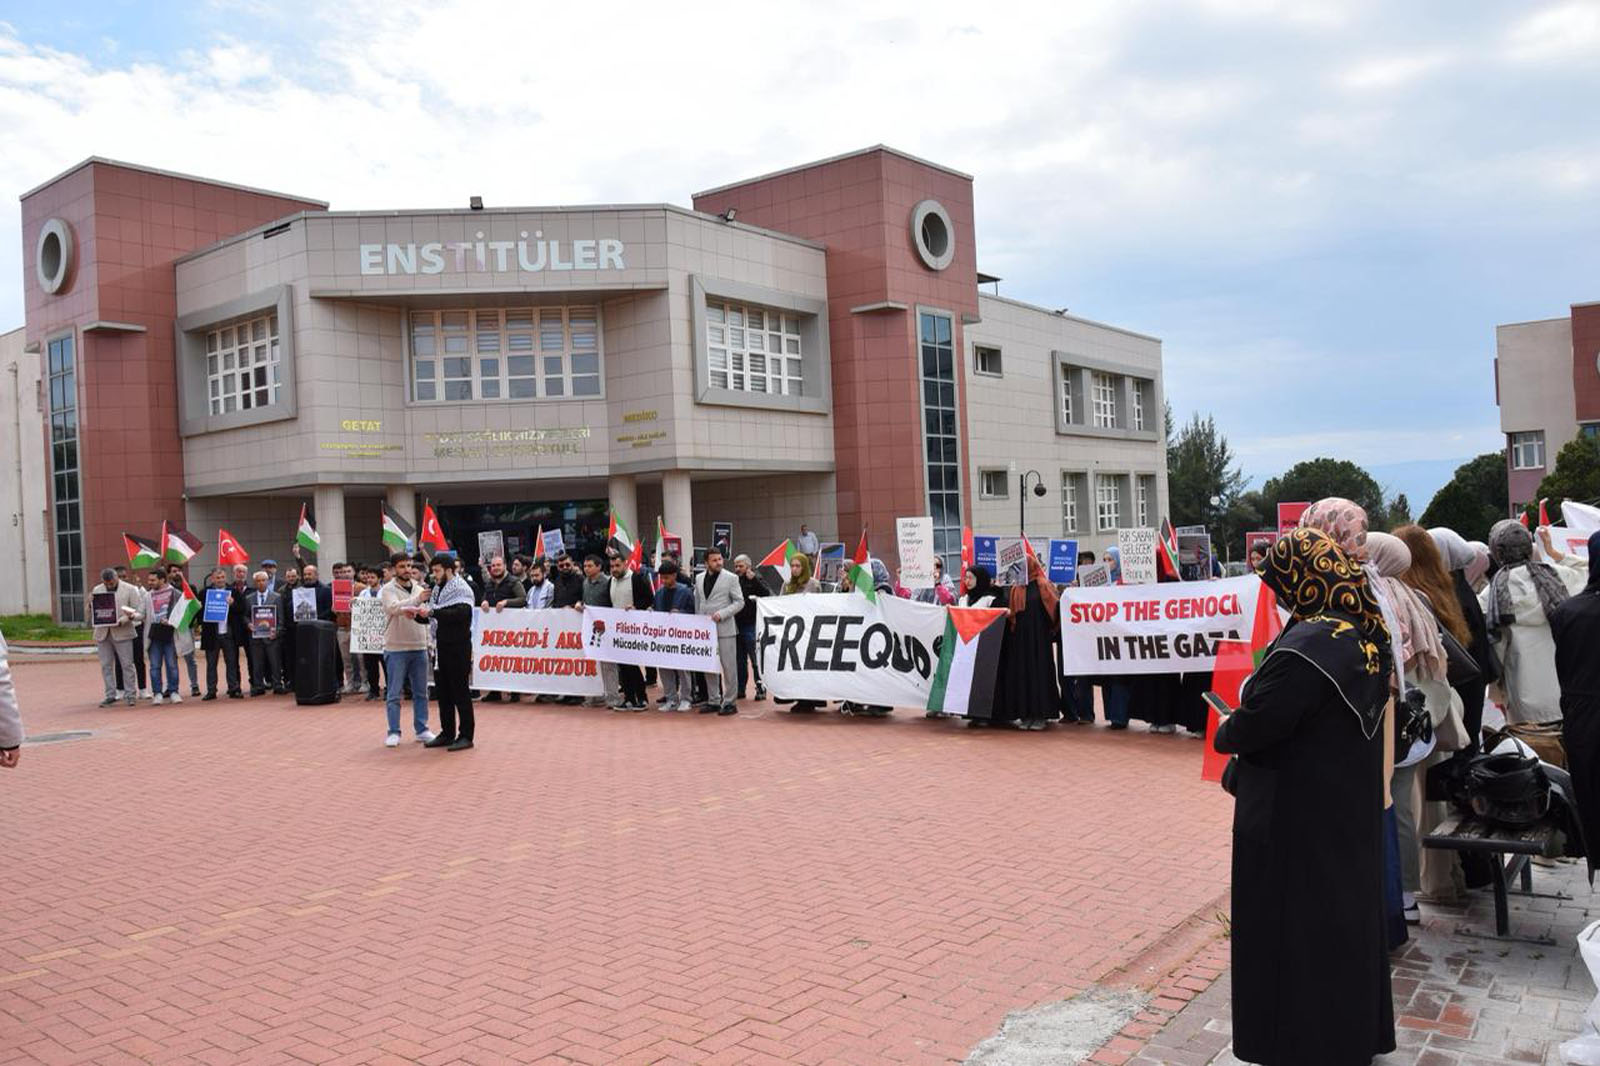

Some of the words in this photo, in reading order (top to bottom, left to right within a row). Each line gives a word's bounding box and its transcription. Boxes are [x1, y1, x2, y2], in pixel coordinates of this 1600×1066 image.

[360, 230, 626, 276] ENSTİTÜLER
[341, 420, 381, 432] GETAT
[1070, 602, 1118, 623] STOP
[1122, 600, 1161, 622] THE
[1164, 594, 1243, 619] GENOCI
[480, 627, 549, 649] MESCİD-İ
[615, 622, 641, 635] Filistin
[642, 623, 667, 639] Özgür
[668, 627, 693, 640] Olana
[694, 629, 711, 641] Dek
[612, 637, 649, 652] Mücadele
[650, 641, 680, 654] Devam
[680, 643, 713, 657] Edecek!
[1097, 636, 1121, 661] IN
[1124, 634, 1171, 660] THE
[479, 655, 598, 677] ONURUMUZDUR
